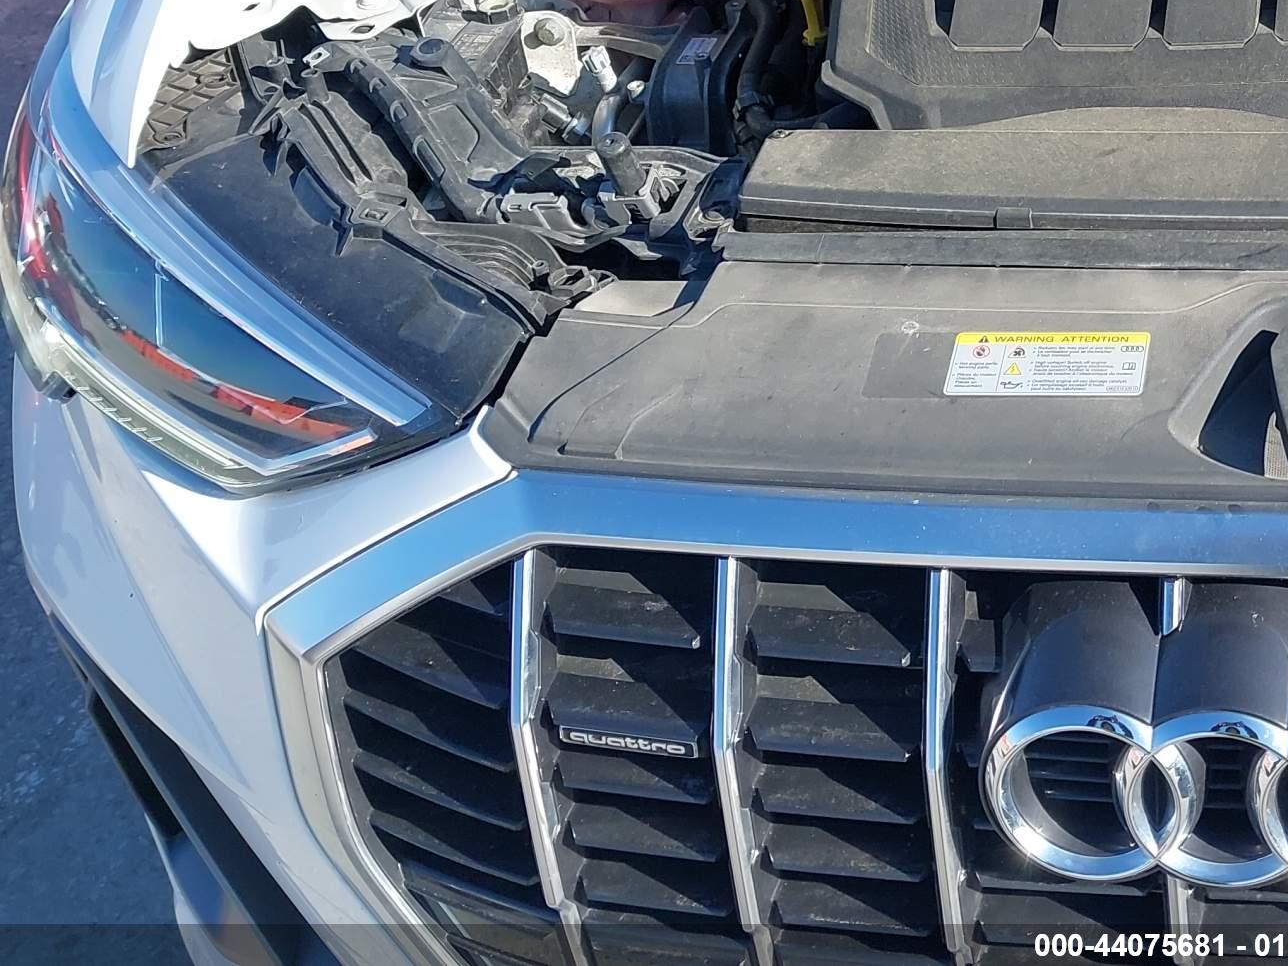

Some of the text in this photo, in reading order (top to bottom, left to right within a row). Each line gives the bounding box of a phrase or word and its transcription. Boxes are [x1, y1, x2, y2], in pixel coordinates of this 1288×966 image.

[994, 335, 1130, 343] WARNING ATTENTION
[569, 731, 686, 755] quattro
